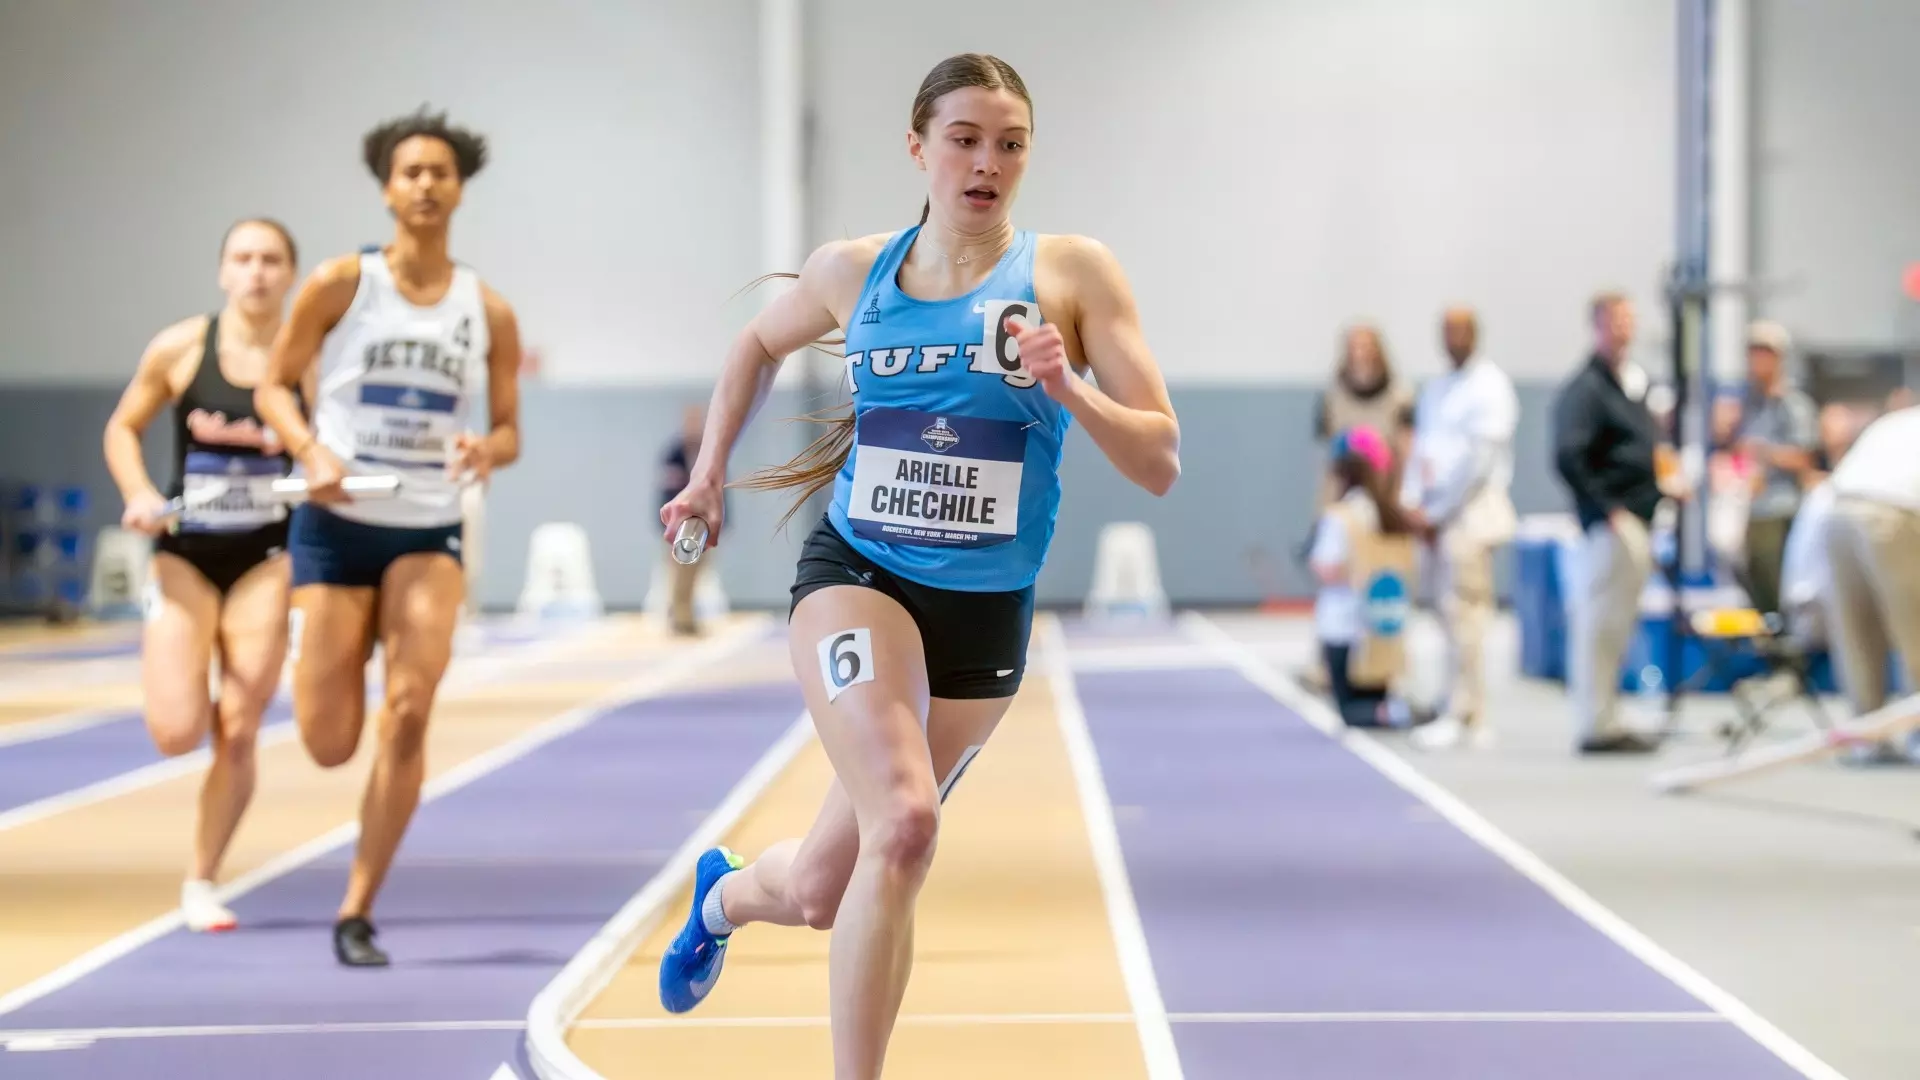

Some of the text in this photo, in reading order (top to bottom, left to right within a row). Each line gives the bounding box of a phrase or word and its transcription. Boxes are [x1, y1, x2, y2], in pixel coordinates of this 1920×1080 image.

[995, 303, 1028, 372] 6
[895, 458, 979, 489] ARIELLE
[870, 485, 997, 525] CHECHILE
[882, 525, 912, 535] ROCHESTER,
[945, 532, 964, 540] MARCH
[829, 632, 861, 688] 6
